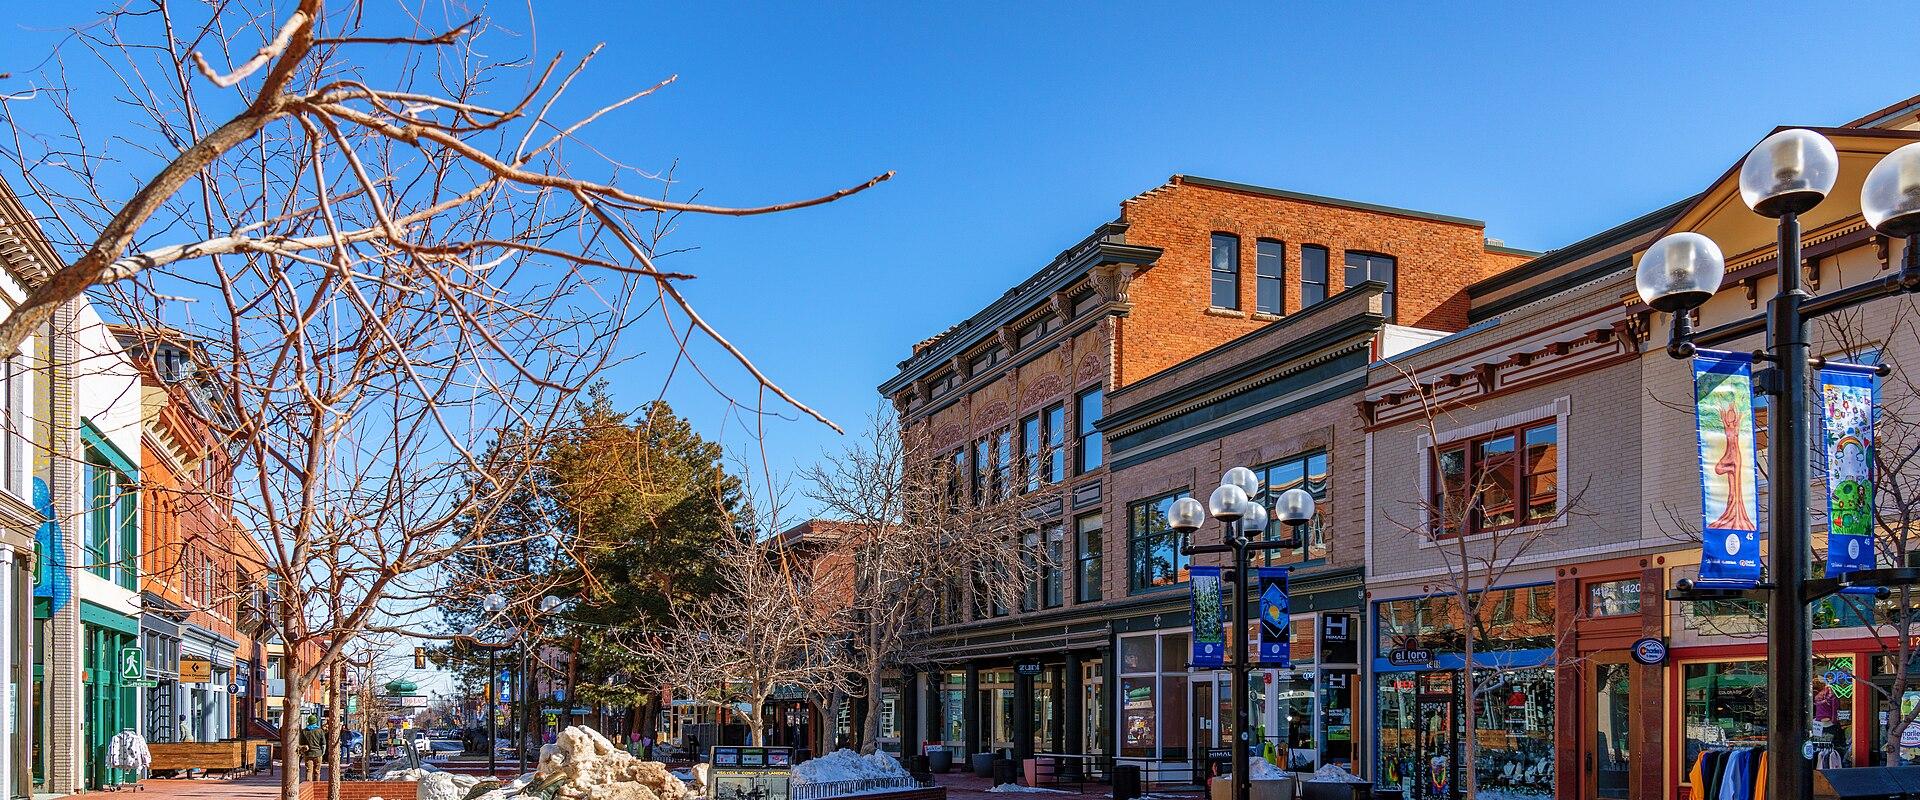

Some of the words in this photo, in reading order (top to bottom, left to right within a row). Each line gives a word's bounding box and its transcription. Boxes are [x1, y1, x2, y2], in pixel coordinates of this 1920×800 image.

[1621, 583, 1641, 593] 1420
[1396, 651, 1405, 659] el
[1408, 651, 1427, 659] loro
[1824, 671, 1853, 684] OPE
